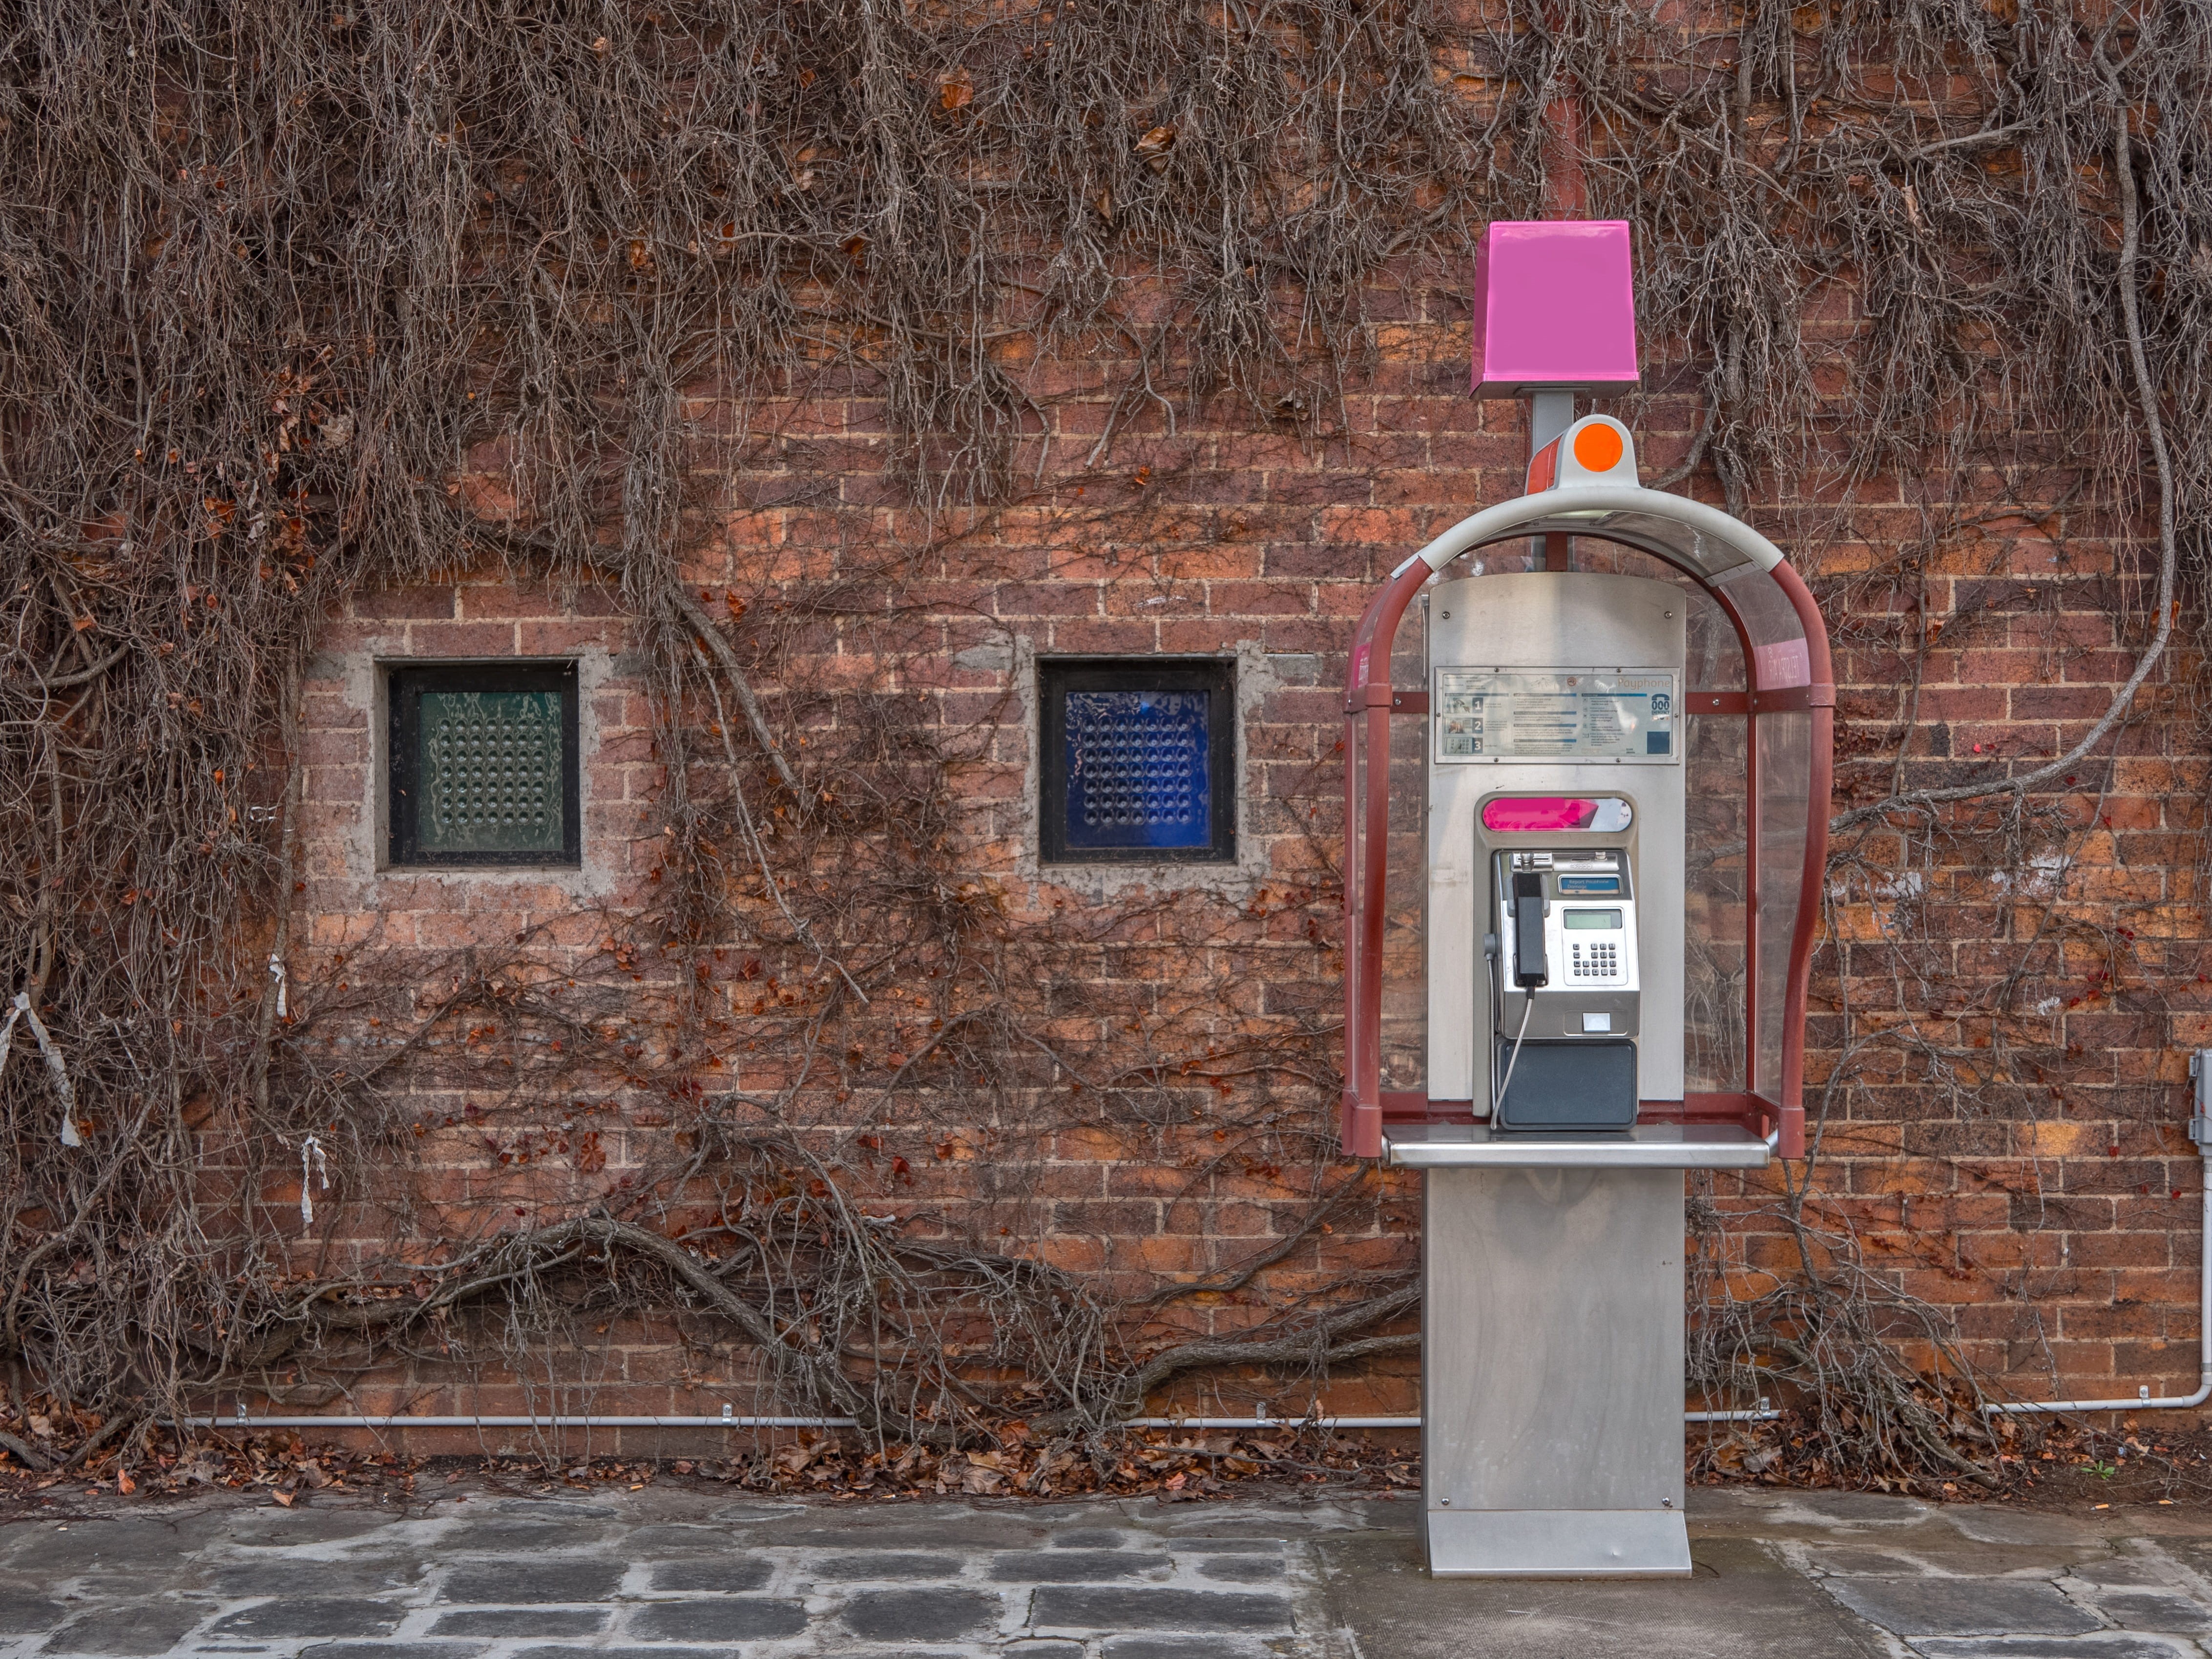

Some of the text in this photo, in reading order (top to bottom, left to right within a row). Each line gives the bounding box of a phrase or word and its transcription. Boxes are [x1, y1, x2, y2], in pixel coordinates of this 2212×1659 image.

[1618, 678, 1670, 690] Payphone
[1475, 701, 1481, 710] 1
[1651, 700, 1669, 710] 000
[1475, 721, 1481, 731] 2
[1475, 741, 1481, 751] 3
